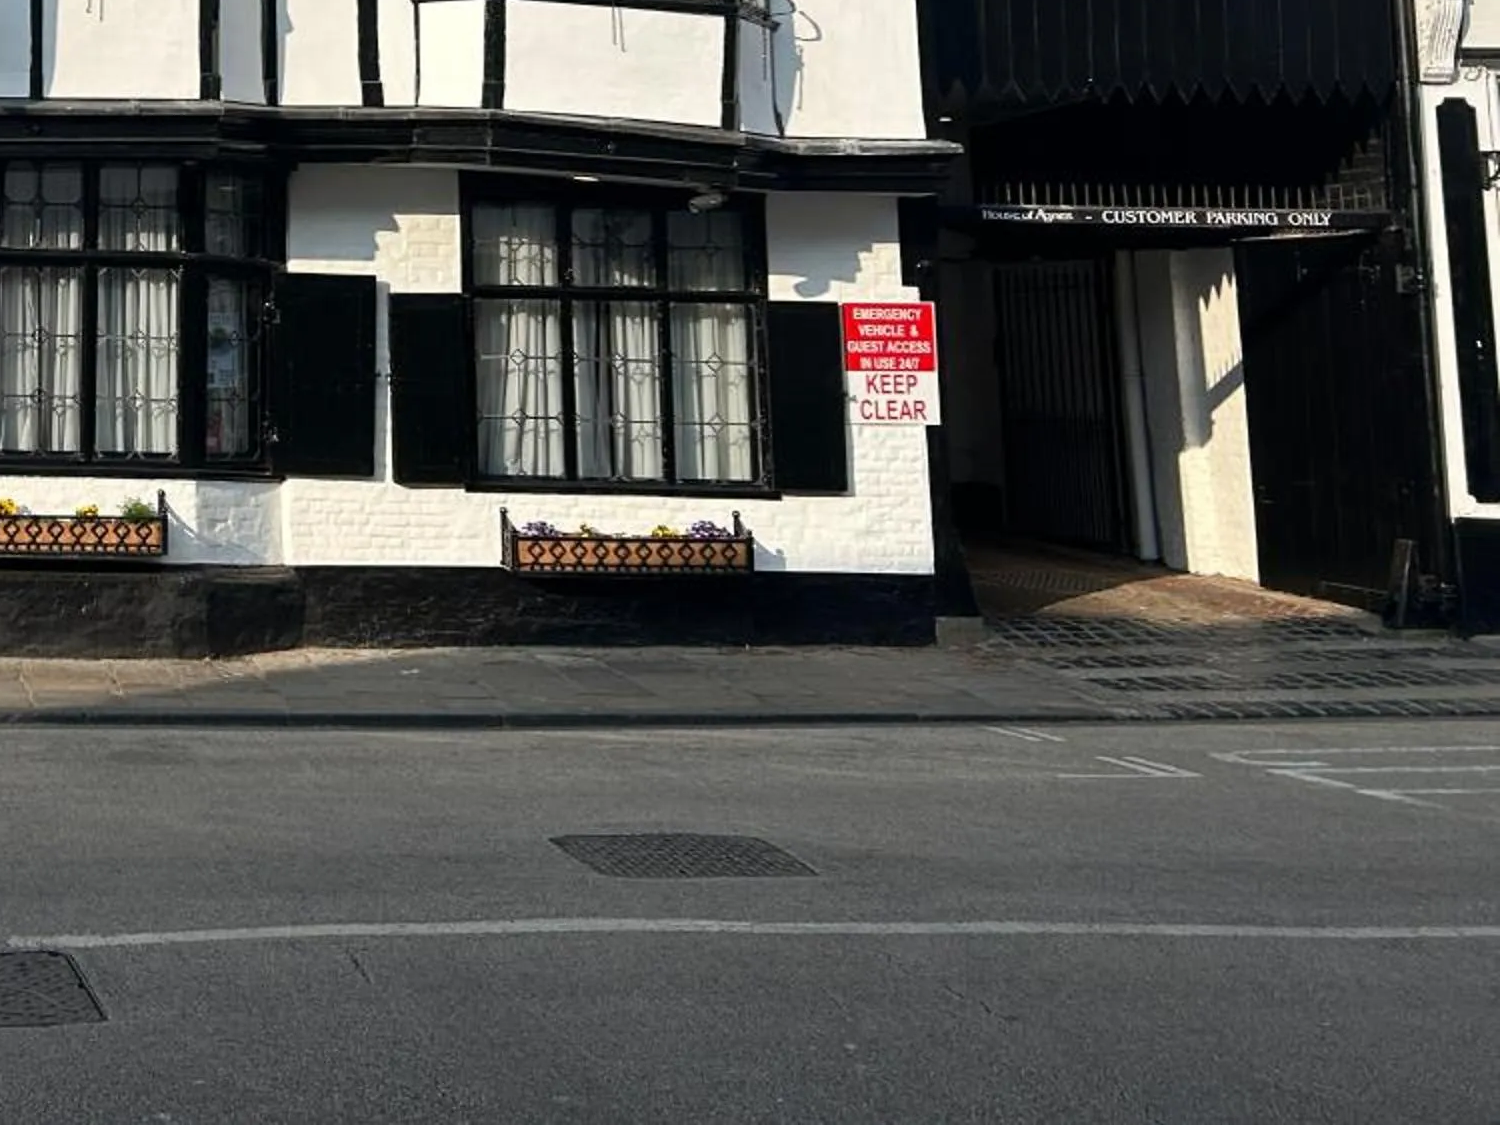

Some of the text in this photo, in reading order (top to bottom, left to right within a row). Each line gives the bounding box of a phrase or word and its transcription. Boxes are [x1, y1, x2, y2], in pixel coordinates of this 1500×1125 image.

[1101, 209, 1197, 224] CUSTOMER
[1206, 211, 1279, 225] PARKING
[1287, 211, 1333, 226] ONLY
[852, 307, 922, 321] EMERGENCY
[857, 323, 920, 338] VEHICLE &
[846, 339, 932, 354] GUEST ACCESS
[859, 356, 872, 370] IN
[873, 356, 897, 370] USE
[865, 373, 918, 395] KEEP
[860, 398, 928, 421] CLEAR
